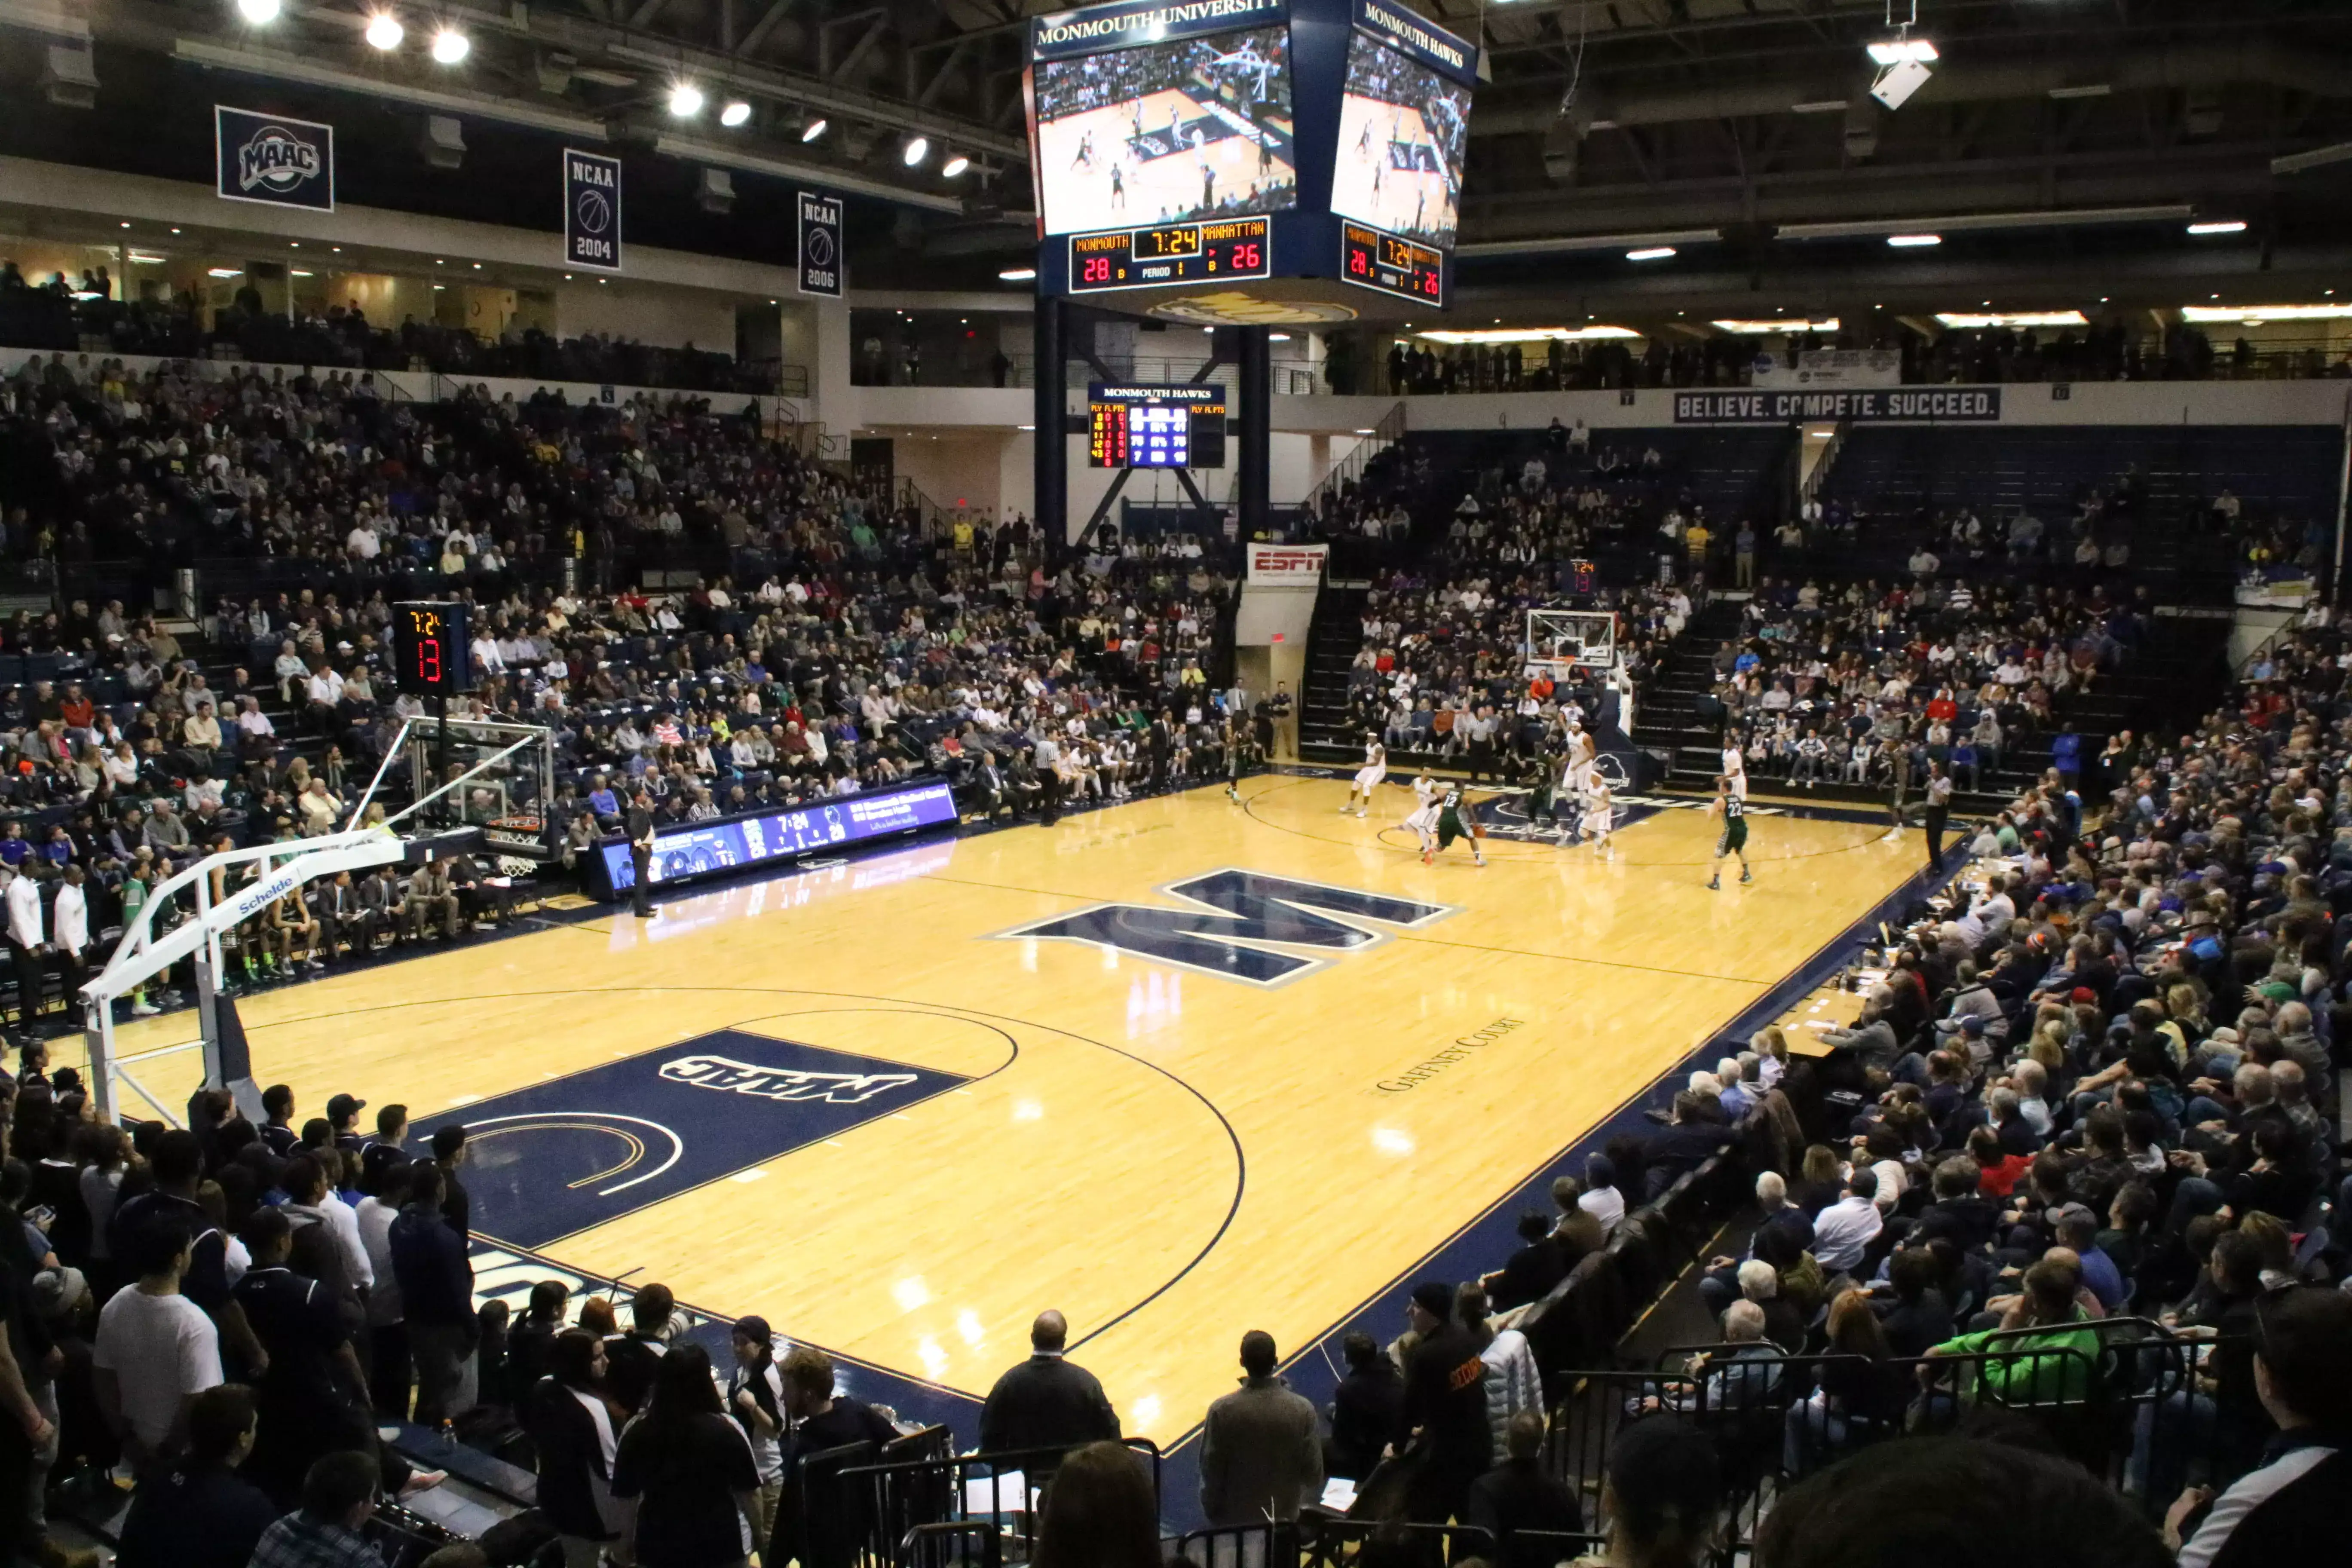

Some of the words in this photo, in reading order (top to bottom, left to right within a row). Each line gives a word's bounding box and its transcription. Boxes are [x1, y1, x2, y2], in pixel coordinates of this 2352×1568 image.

[1038, 10, 1155, 45] MONMOUTH
[1365, 2, 1429, 50] MONMOUTH
[1430, 37, 1464, 68] HAWKS
[241, 143, 318, 188] MAAC
[573, 162, 613, 187] NCAA
[805, 203, 836, 226] NCAA
[1201, 221, 1264, 240] MANHATTAN
[577, 237, 611, 259] 2004
[1076, 235, 1129, 252] MONMOUTH
[1152, 231, 1197, 253] 7:24
[1209, 260, 1216, 271] B
[1232, 244, 1259, 268] 26
[1351, 249, 1366, 275] 28
[808, 268, 834, 288] 2006
[1084, 258, 1110, 281] 28
[1118, 269, 1125, 279] B
[1142, 266, 1170, 278] PERIOD
[1178, 262, 1183, 275] 1
[1425, 272, 1438, 295] 26
[1104, 389, 1170, 398] MONMOUTH
[1172, 389, 1211, 398] HAWKS
[1679, 396, 1769, 417] BELIEVE.
[1776, 393, 1882, 416] COMPETE.
[1889, 392, 1995, 416] SUCCEED.
[1255, 552, 1324, 570] ESPN
[1575, 573, 1589, 592] 13
[418, 640, 441, 683] 13
[1443, 795, 1457, 807] 12
[1728, 803, 1742, 817] 22
[778, 813, 810, 833] 7:24
[239, 878, 293, 914] Schelde
[1377, 1045, 1472, 1091] GAFFNEY
[1455, 1017, 1525, 1047] COURT
